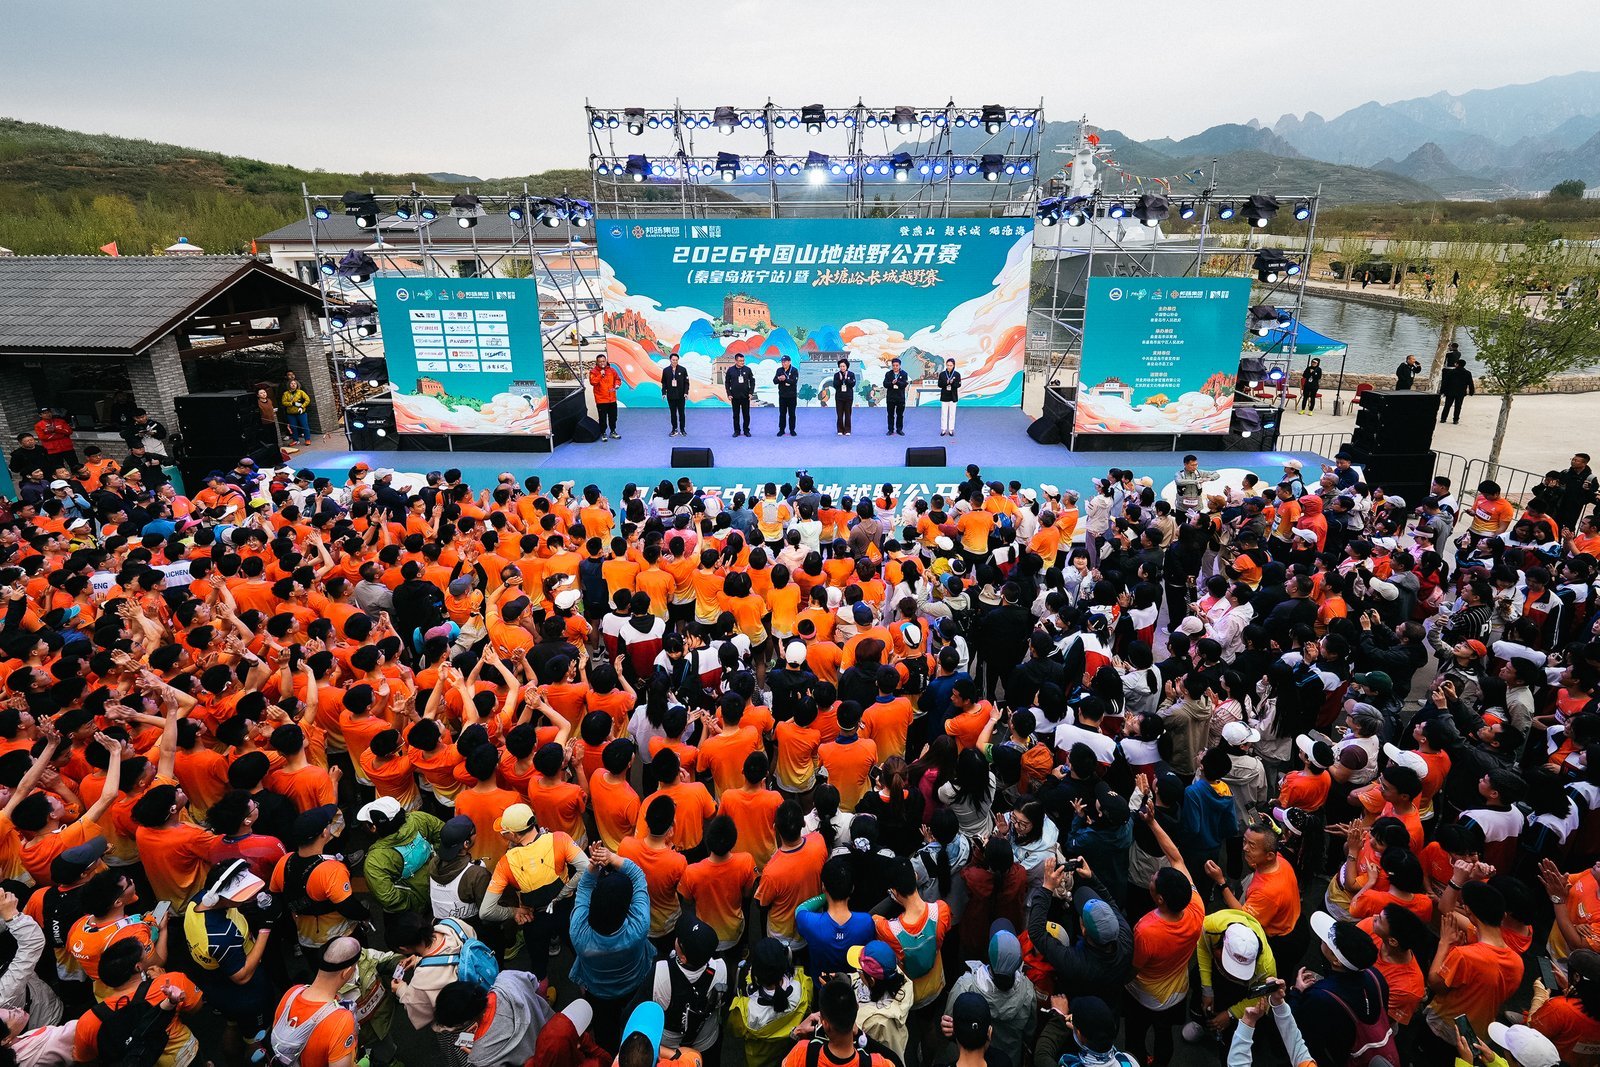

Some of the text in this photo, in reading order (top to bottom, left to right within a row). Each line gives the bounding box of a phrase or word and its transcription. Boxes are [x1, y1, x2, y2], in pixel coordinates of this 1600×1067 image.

[672, 244, 962, 265] 2026中国山地越野公开赛
